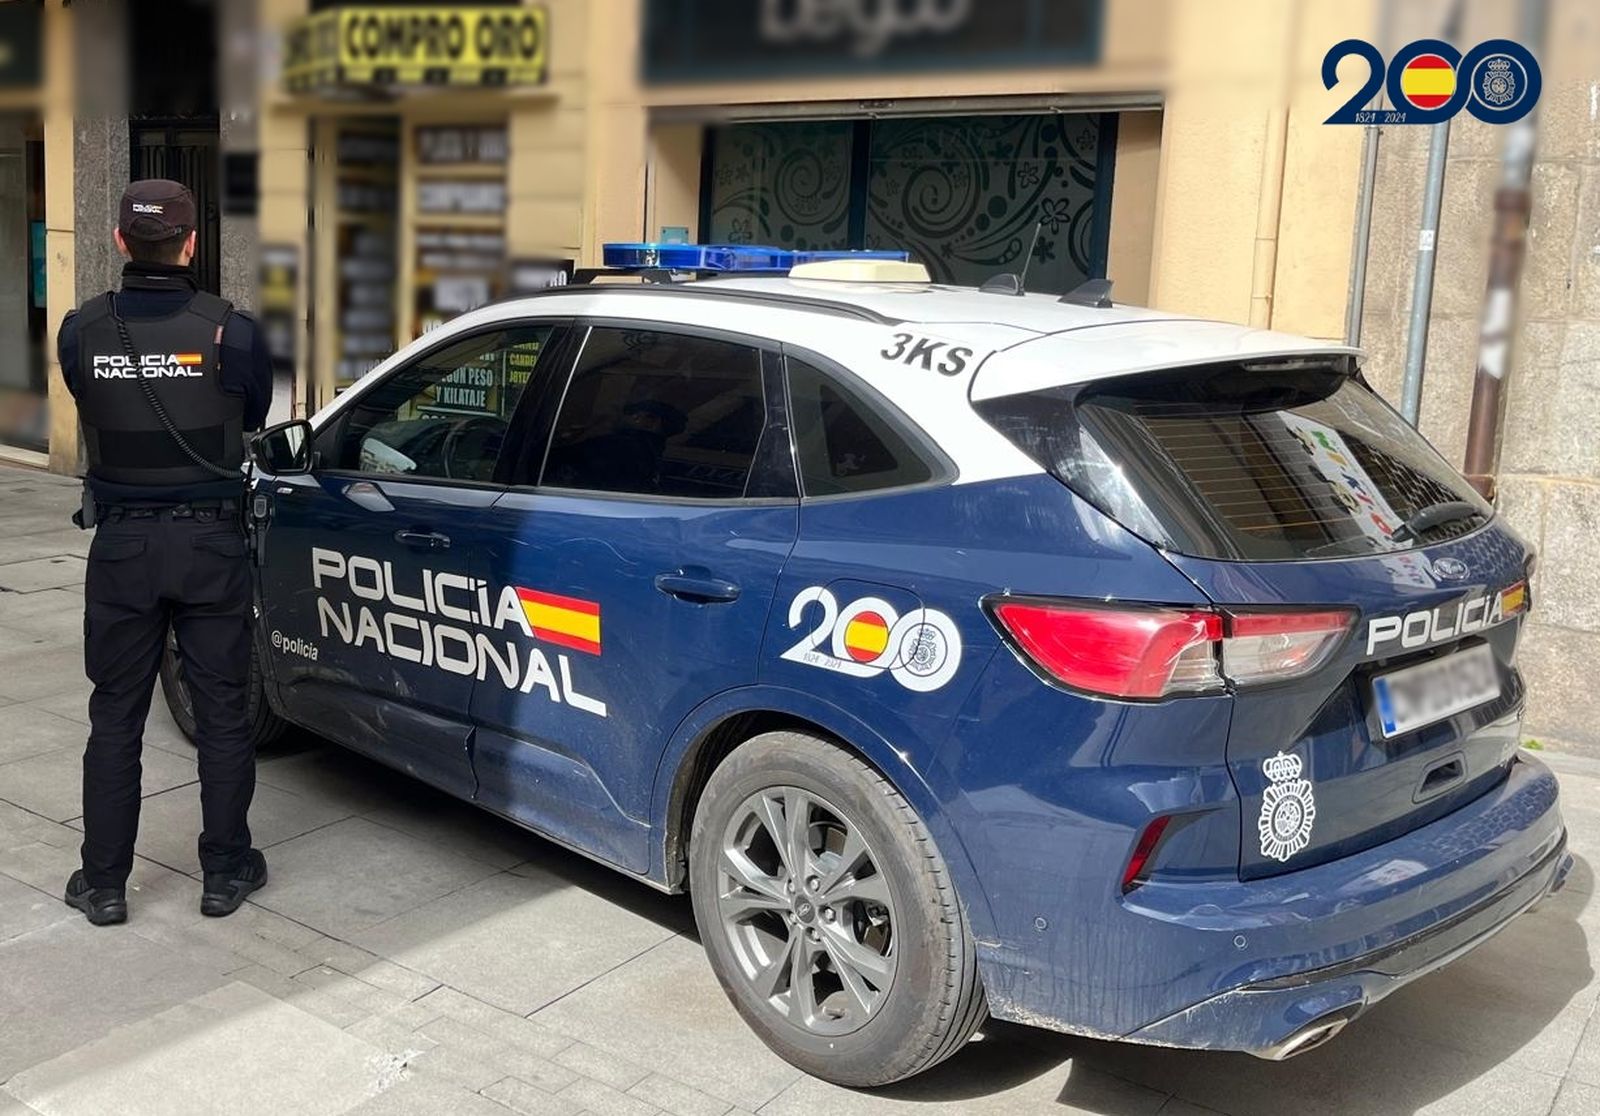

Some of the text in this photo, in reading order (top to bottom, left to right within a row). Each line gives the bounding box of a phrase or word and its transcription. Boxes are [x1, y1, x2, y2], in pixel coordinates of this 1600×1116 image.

[475, 15, 541, 60] ORO
[94, 366, 203, 378] NACONAL
[881, 333, 973, 377] 3KS
[468, 367, 493, 386] PESO
[436, 386, 486, 407] Y KILATAJE
[271, 630, 319, 661] @policia
[317, 596, 607, 717] NACIONAL
[779, 586, 962, 692] 200
